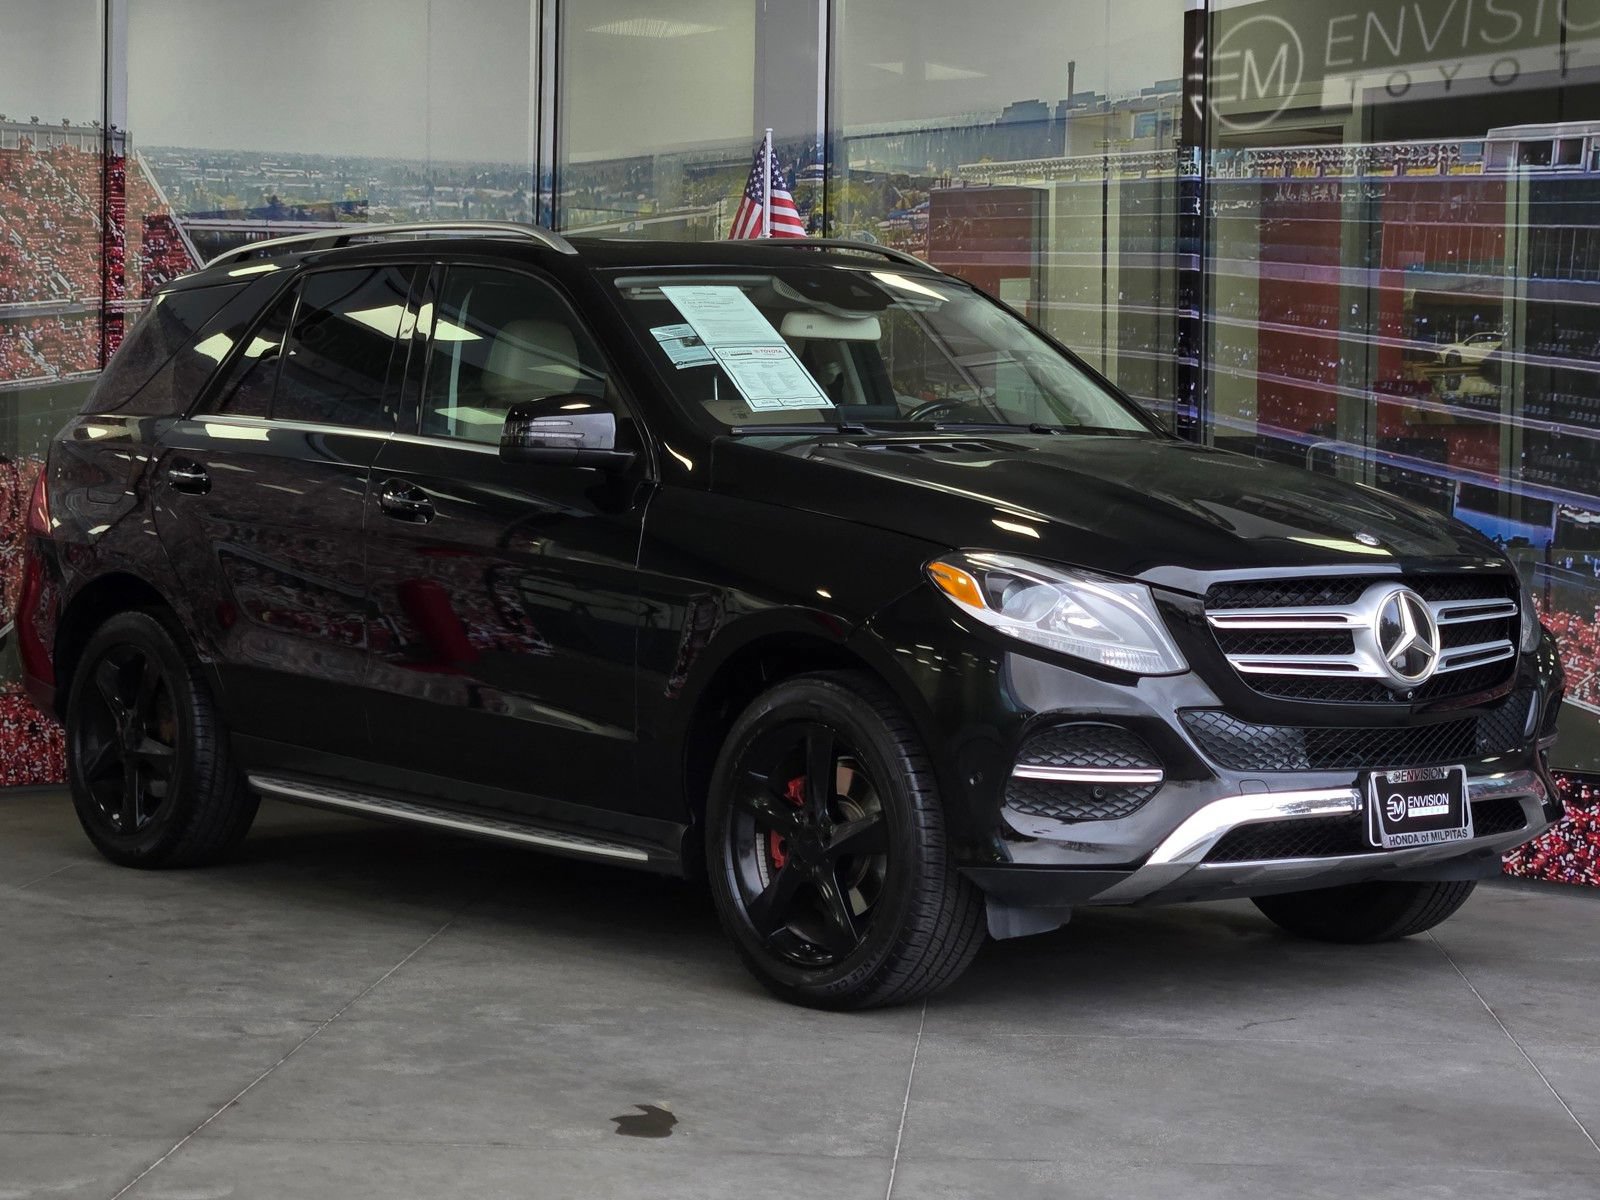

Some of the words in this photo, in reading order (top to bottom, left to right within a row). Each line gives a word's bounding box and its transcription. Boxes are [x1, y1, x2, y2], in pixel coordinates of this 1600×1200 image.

[1400, 767, 1445, 782] ENVISION
[1407, 792, 1449, 808] ENVISION
[1389, 833, 1419, 846] HONDA
[1421, 832, 1429, 843] of
[1430, 828, 1468, 842] MILPITAS
